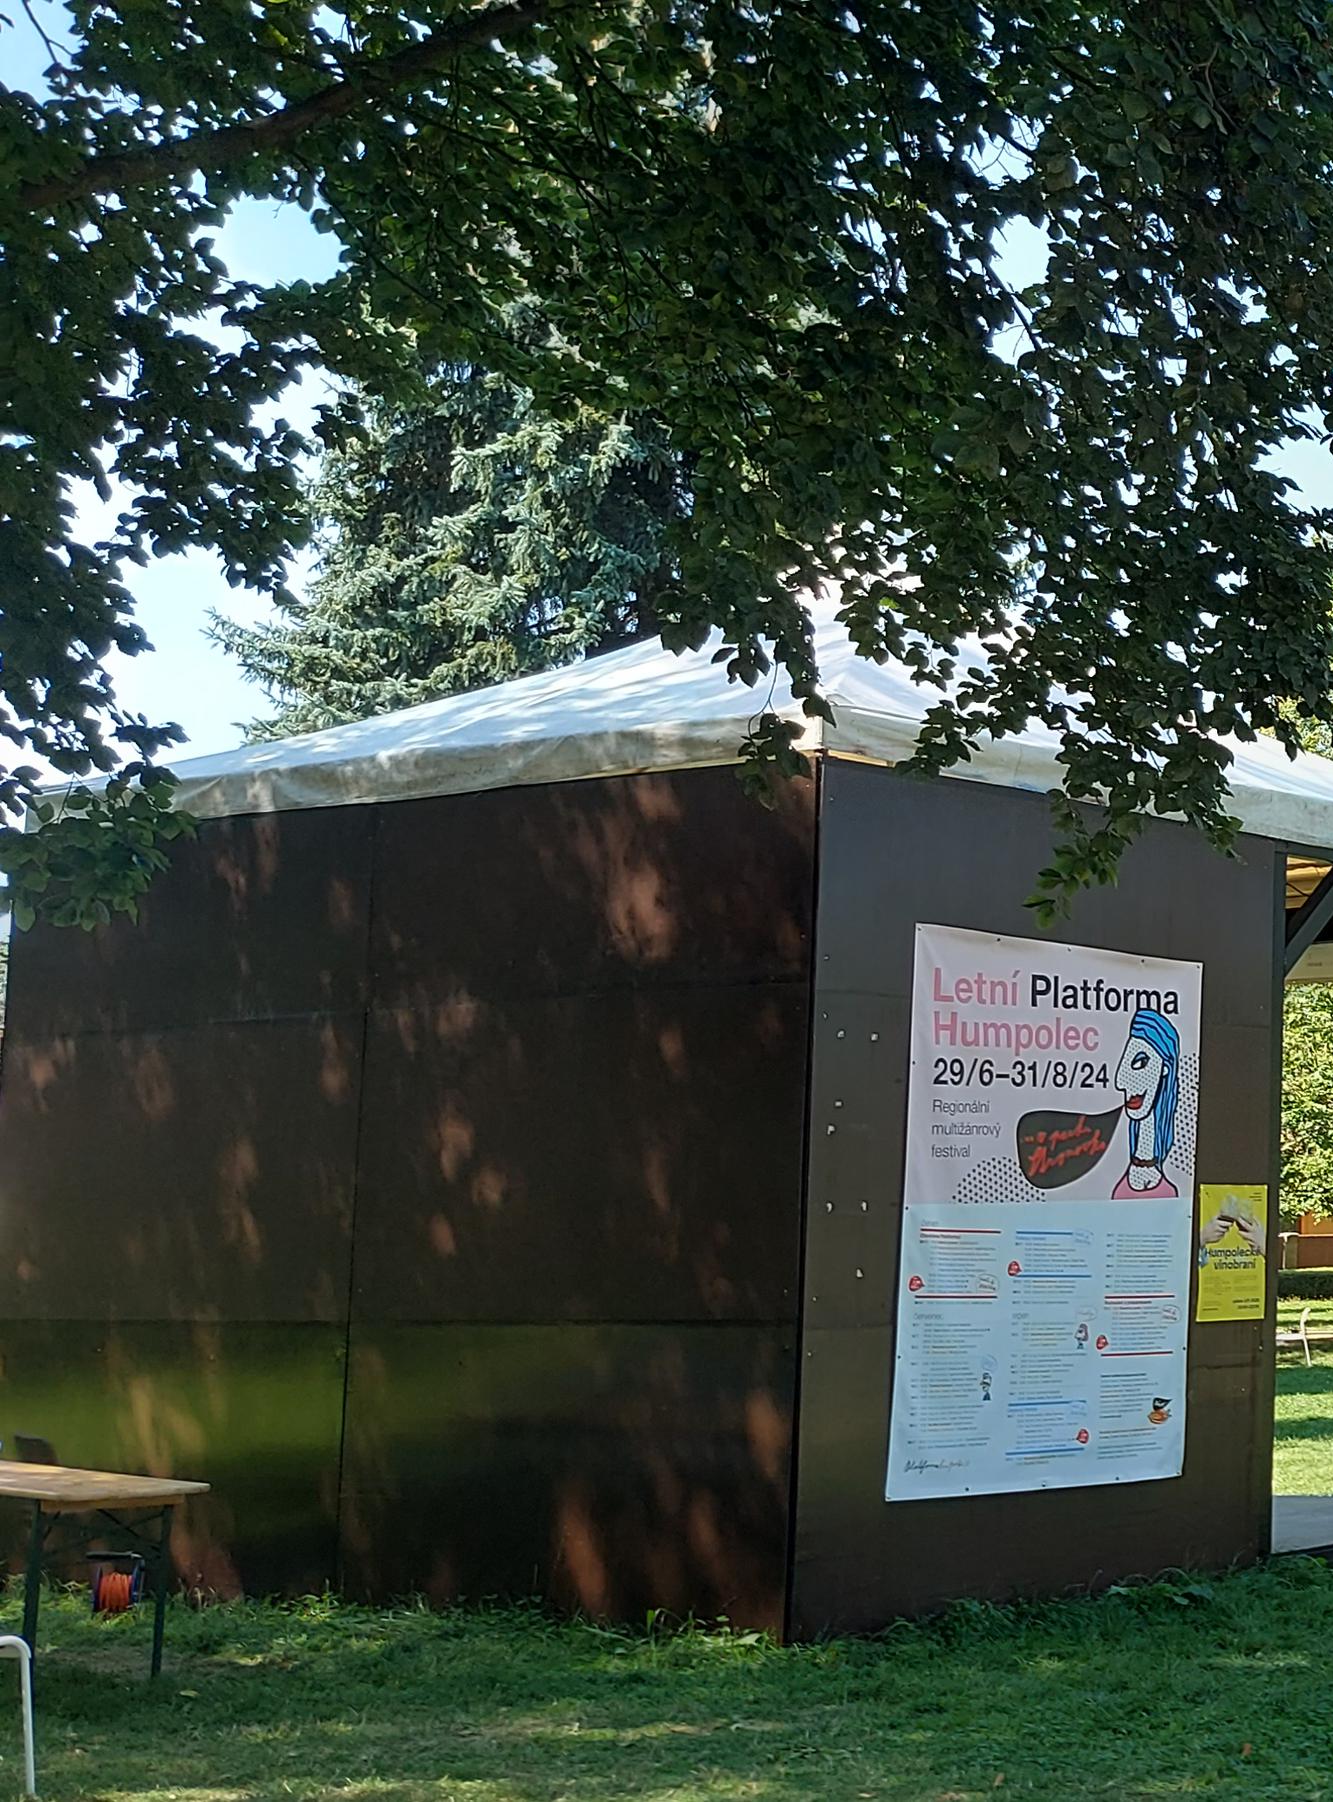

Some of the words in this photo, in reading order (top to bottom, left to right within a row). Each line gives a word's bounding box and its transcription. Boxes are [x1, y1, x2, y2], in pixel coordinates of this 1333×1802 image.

[933, 967, 1020, 1006] Letní
[1031, 973, 1180, 1015] Platforma
[933, 1010, 1100, 1057] Humpolec
[932, 1098, 990, 1116] Regionální
[931, 1144, 971, 1158] festival
